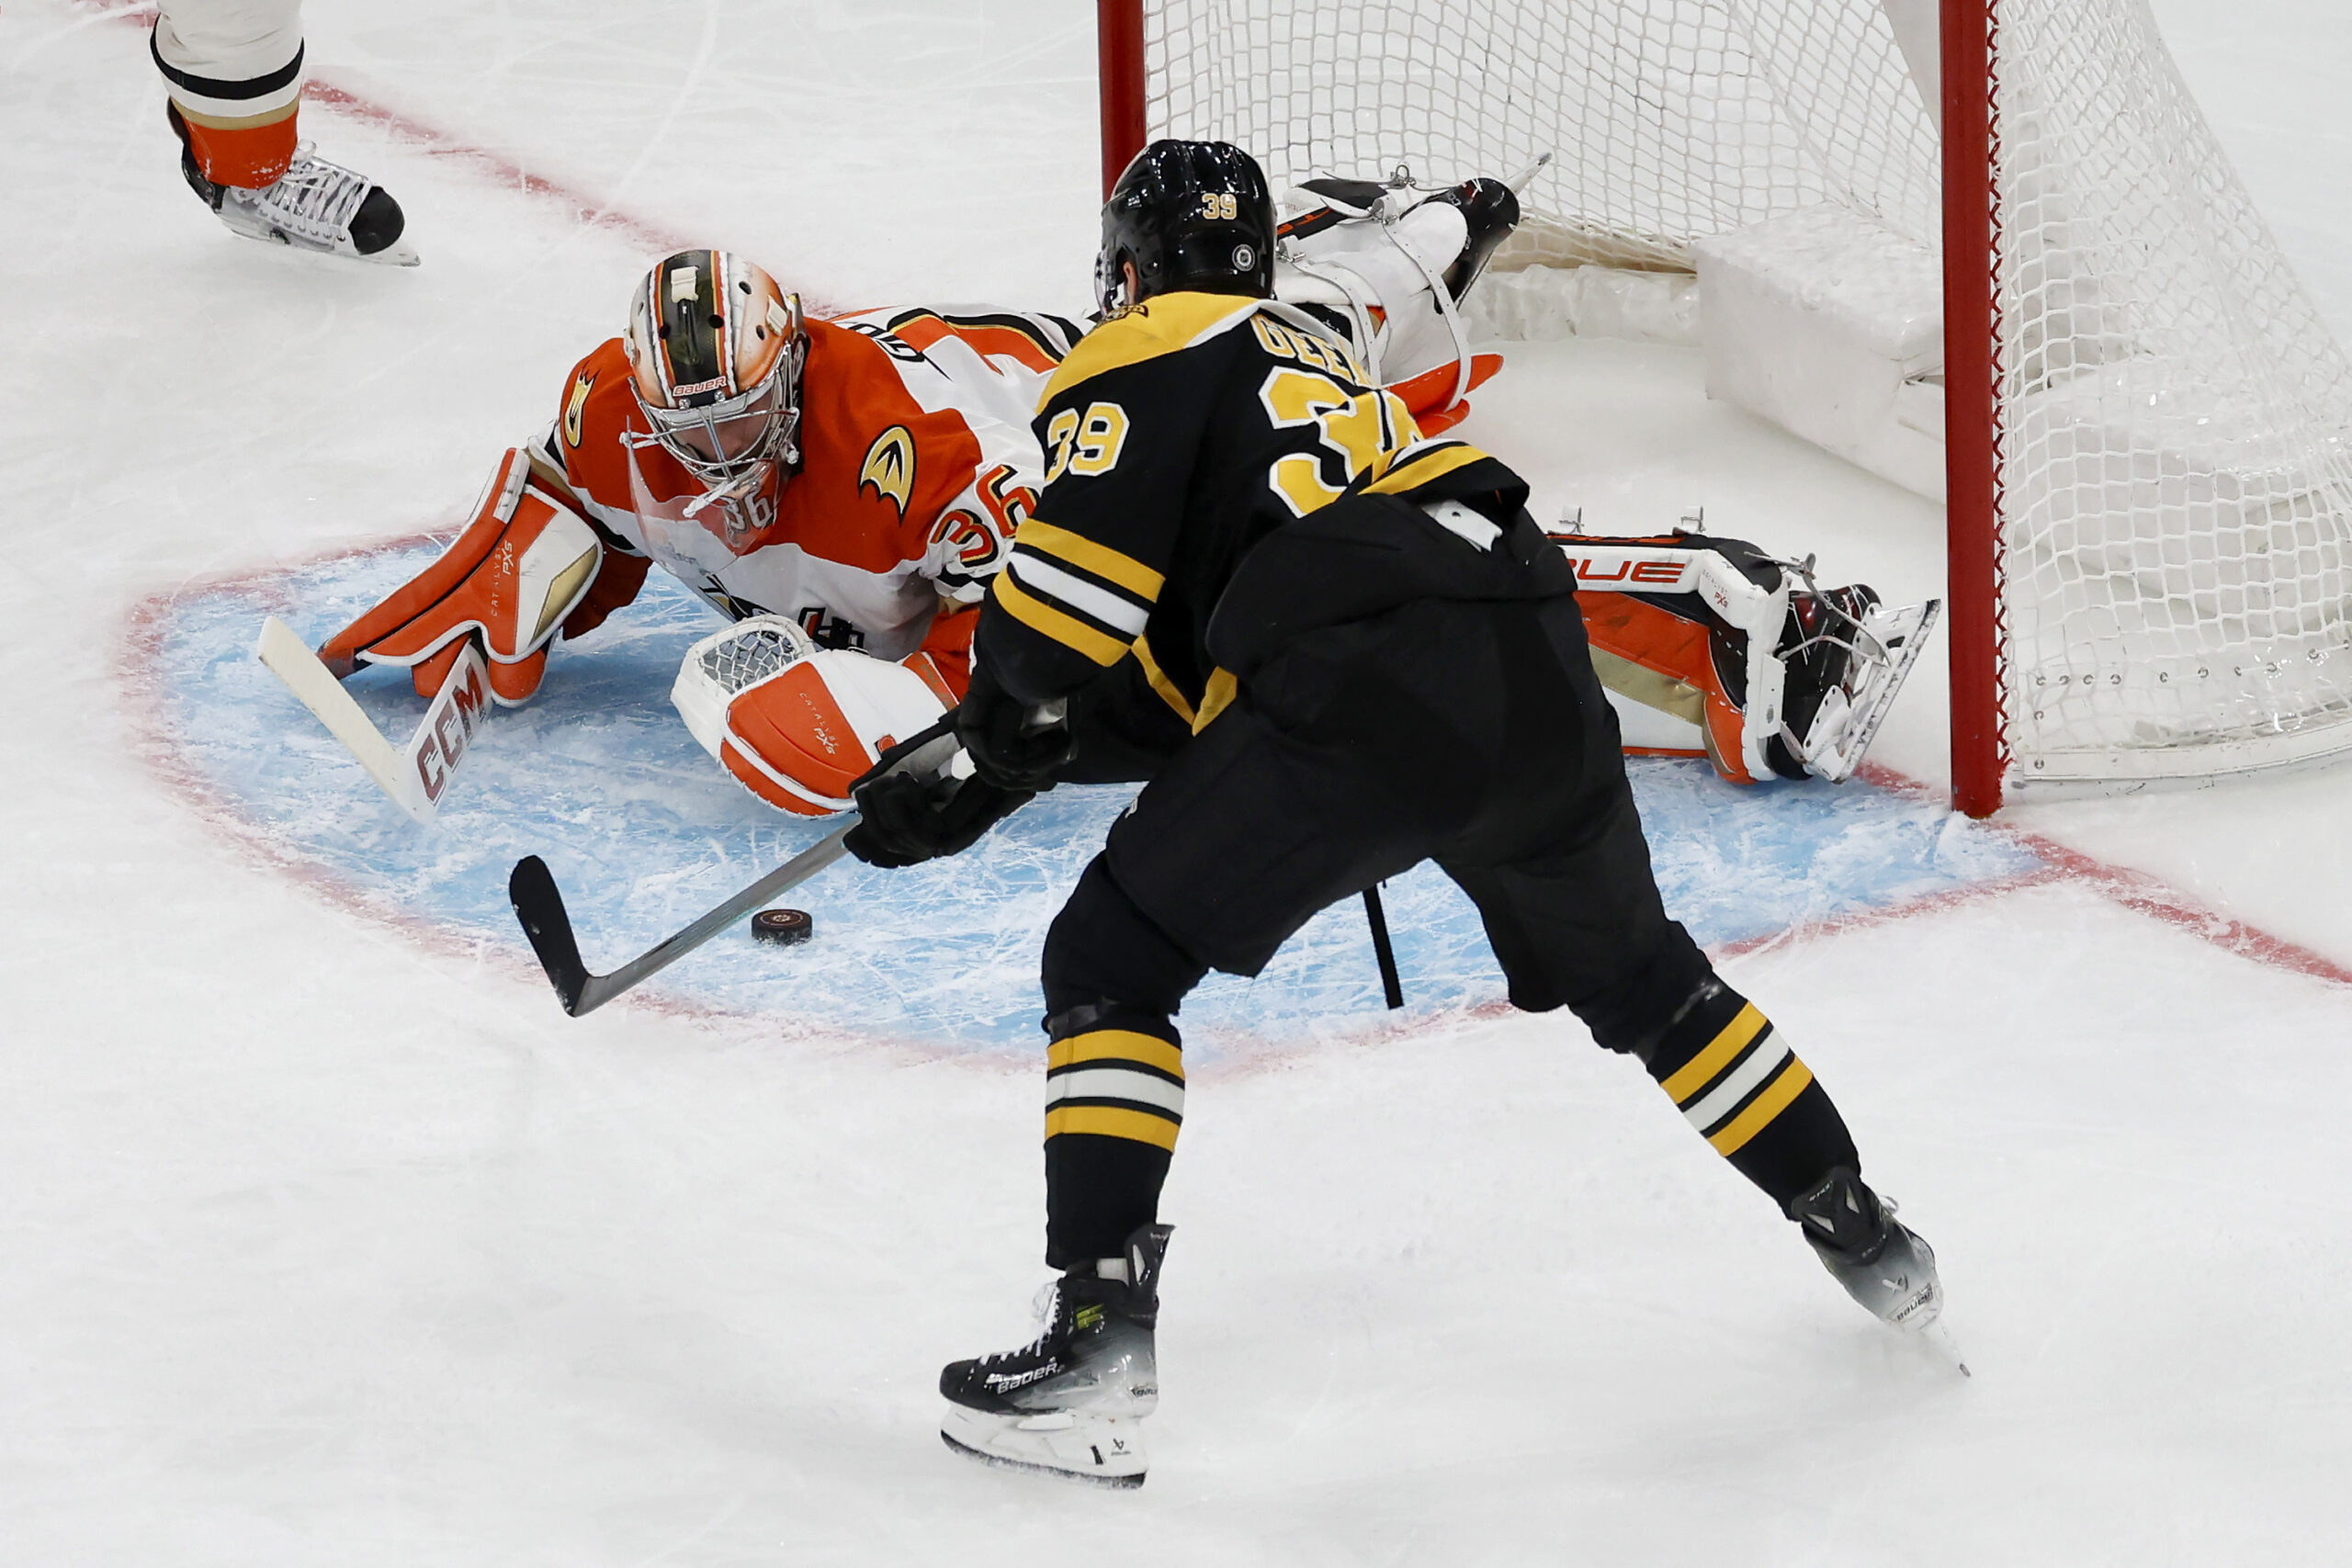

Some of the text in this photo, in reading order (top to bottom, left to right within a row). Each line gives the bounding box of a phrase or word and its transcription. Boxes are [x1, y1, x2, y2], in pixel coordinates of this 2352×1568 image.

[1202, 193, 1238, 220] 39
[673, 375, 728, 397] BAUER
[1046, 401, 1131, 488] 39
[928, 464, 1039, 568] 36
[501, 540, 514, 576] PXS
[416, 661, 488, 807] CCM
[997, 1361, 1058, 1395] BAUER
